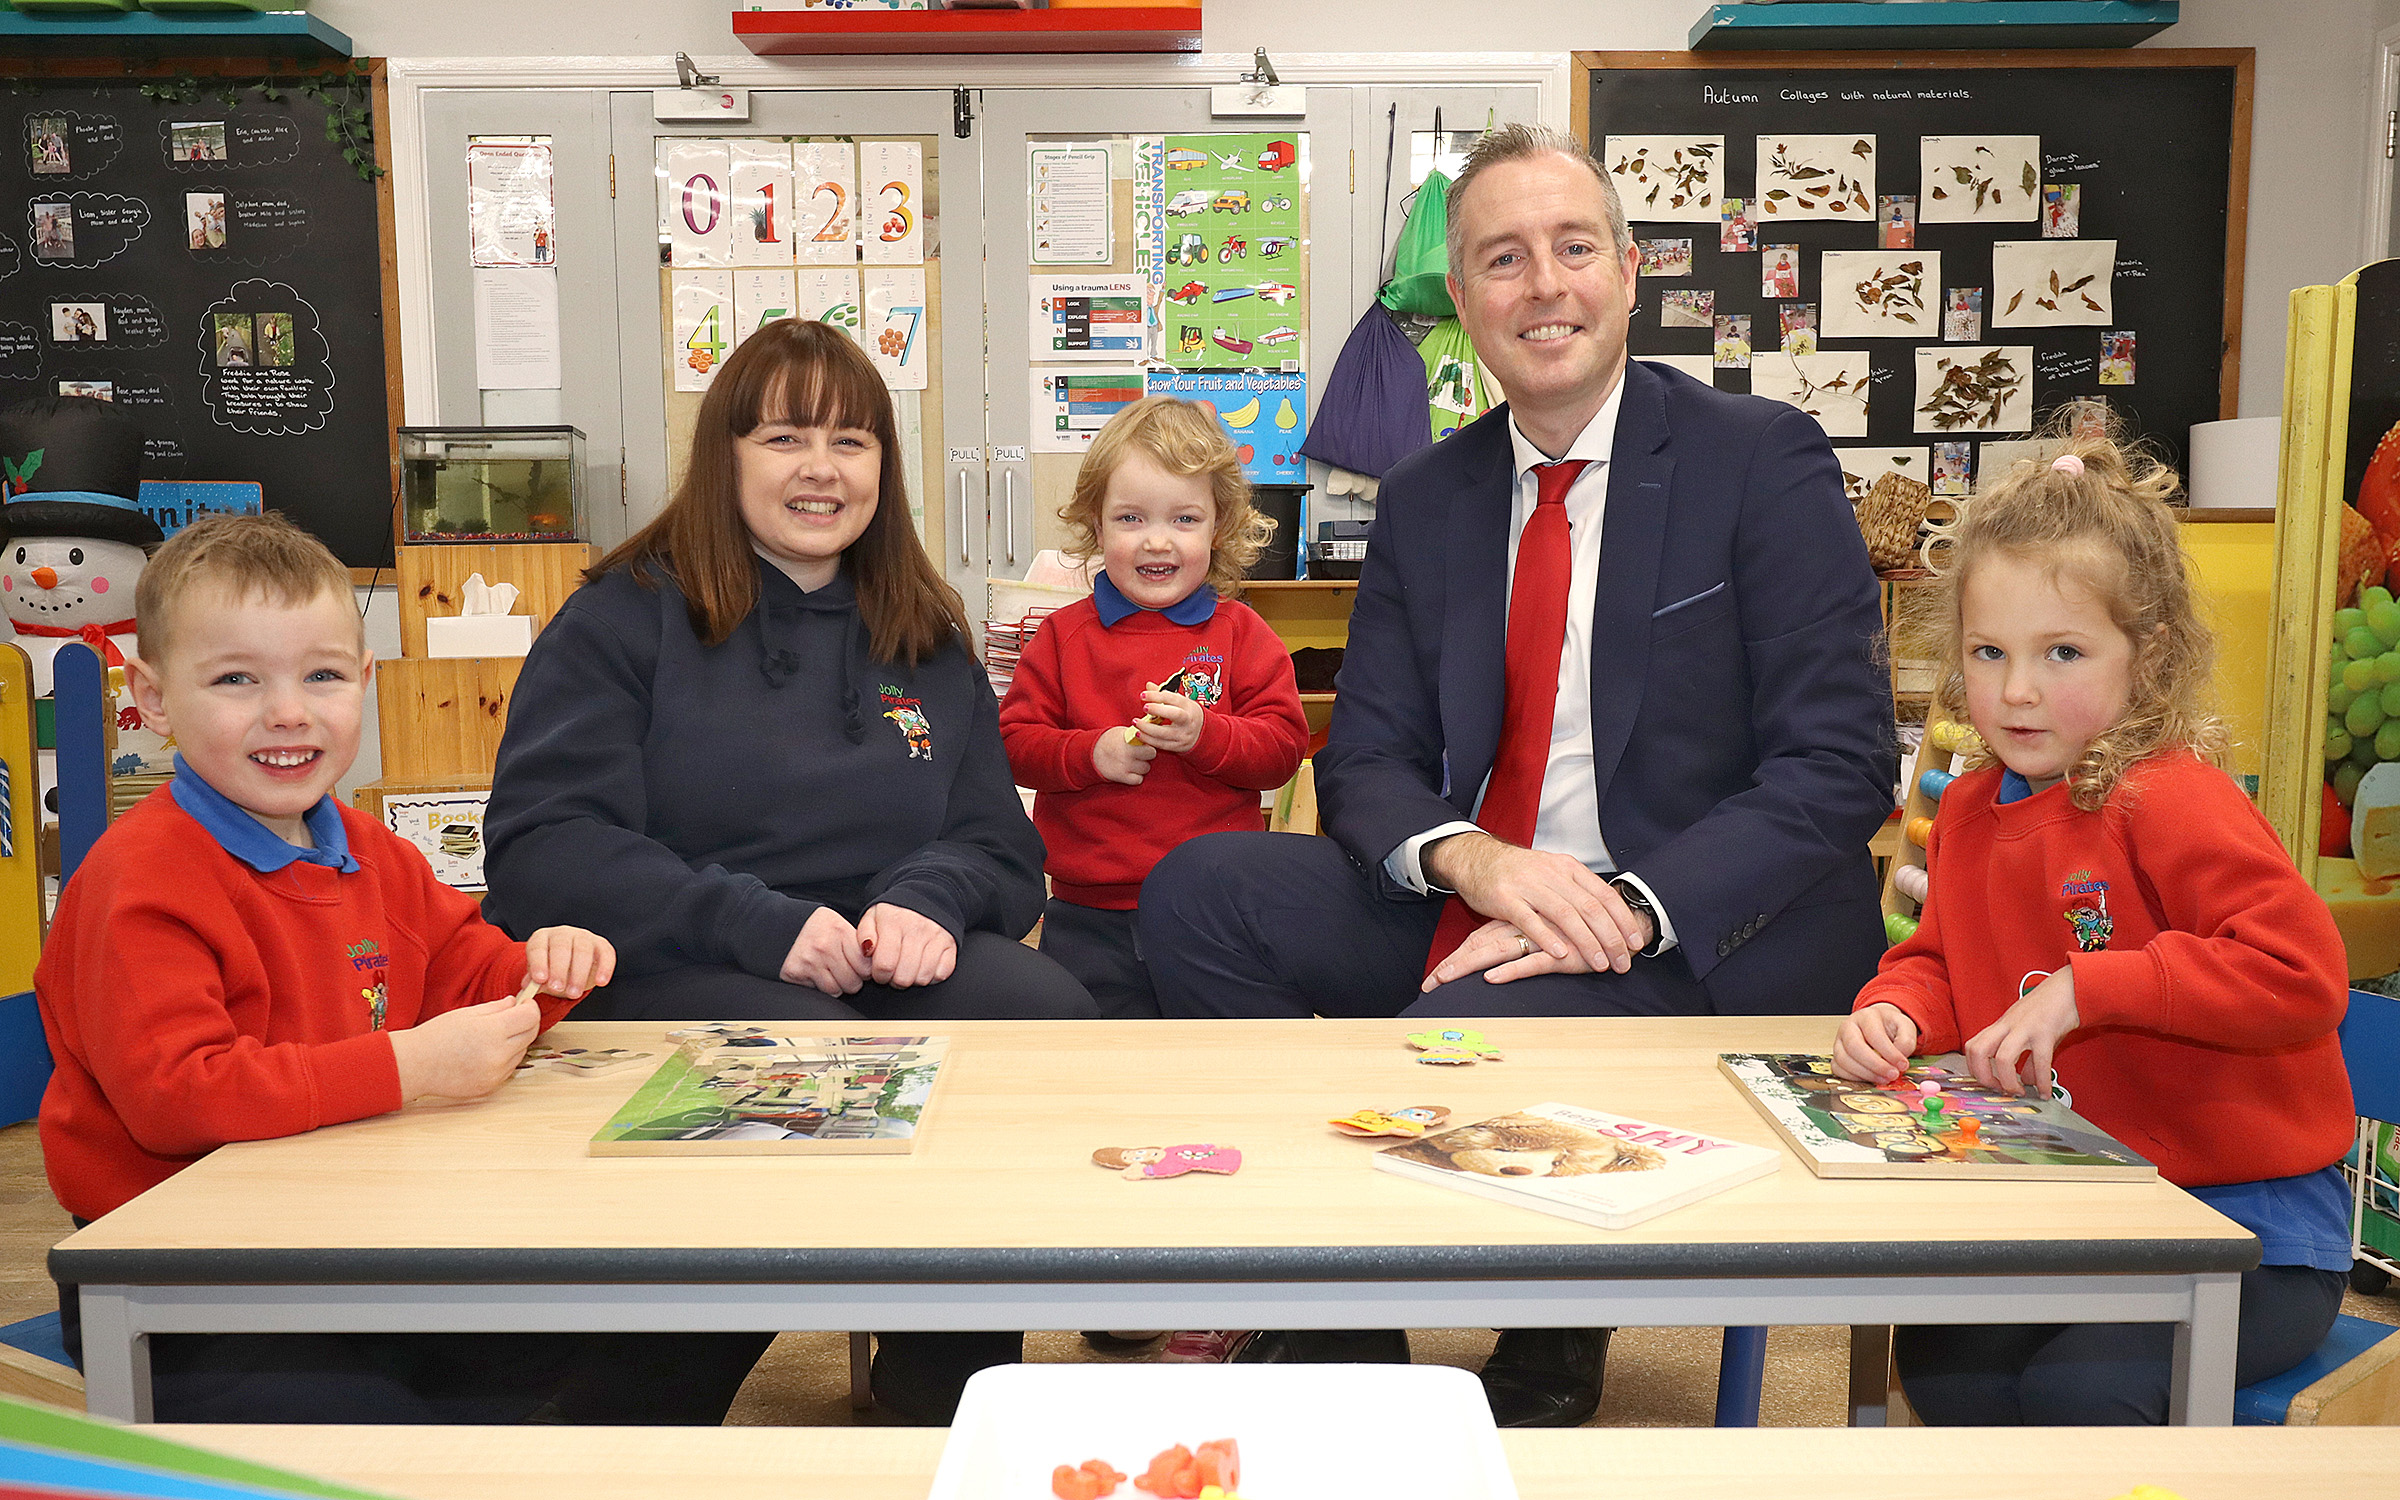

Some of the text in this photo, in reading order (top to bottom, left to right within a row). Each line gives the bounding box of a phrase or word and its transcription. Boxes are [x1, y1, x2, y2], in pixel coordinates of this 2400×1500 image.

[1704, 85, 1973, 105] Autumn Collages with natural materials.
[2045, 153, 2080, 164] Darragh
[682, 173, 721, 235] 0
[756, 183, 781, 243] 1
[812, 182, 849, 242] 2
[880, 181, 913, 242] 3
[1152, 141, 1164, 285] TRANSPORTING
[1052, 284, 1075, 292] Using
[1109, 283, 1131, 291] LENS
[1056, 313, 1062, 321] E
[687, 305, 727, 364] 4
[886, 306, 923, 366] 7
[1056, 340, 1063, 348] S
[222, 367, 252, 377] Freddie
[269, 369, 291, 377] Rose
[1058, 379, 1065, 387] L
[1172, 375, 1196, 391] Your
[1198, 376, 1223, 391] Fruit
[1225, 374, 1245, 391] and
[1246, 376, 1301, 395] Vegetables
[221, 391, 241, 400] They
[257, 392, 287, 401] brought
[1058, 392, 1065, 400] E
[225, 400, 262, 408] treasures
[247, 407, 282, 417] friends.
[1058, 418, 1065, 426] S
[951, 450, 978, 460] PULL
[996, 449, 1022, 459] PULL
[879, 683, 904, 698] Jolly
[880, 694, 922, 705] Pirates
[2062, 881, 2110, 897] Pirates
[352, 955, 389, 972] Pirate
[1597, 1123, 1739, 1155] SHY
